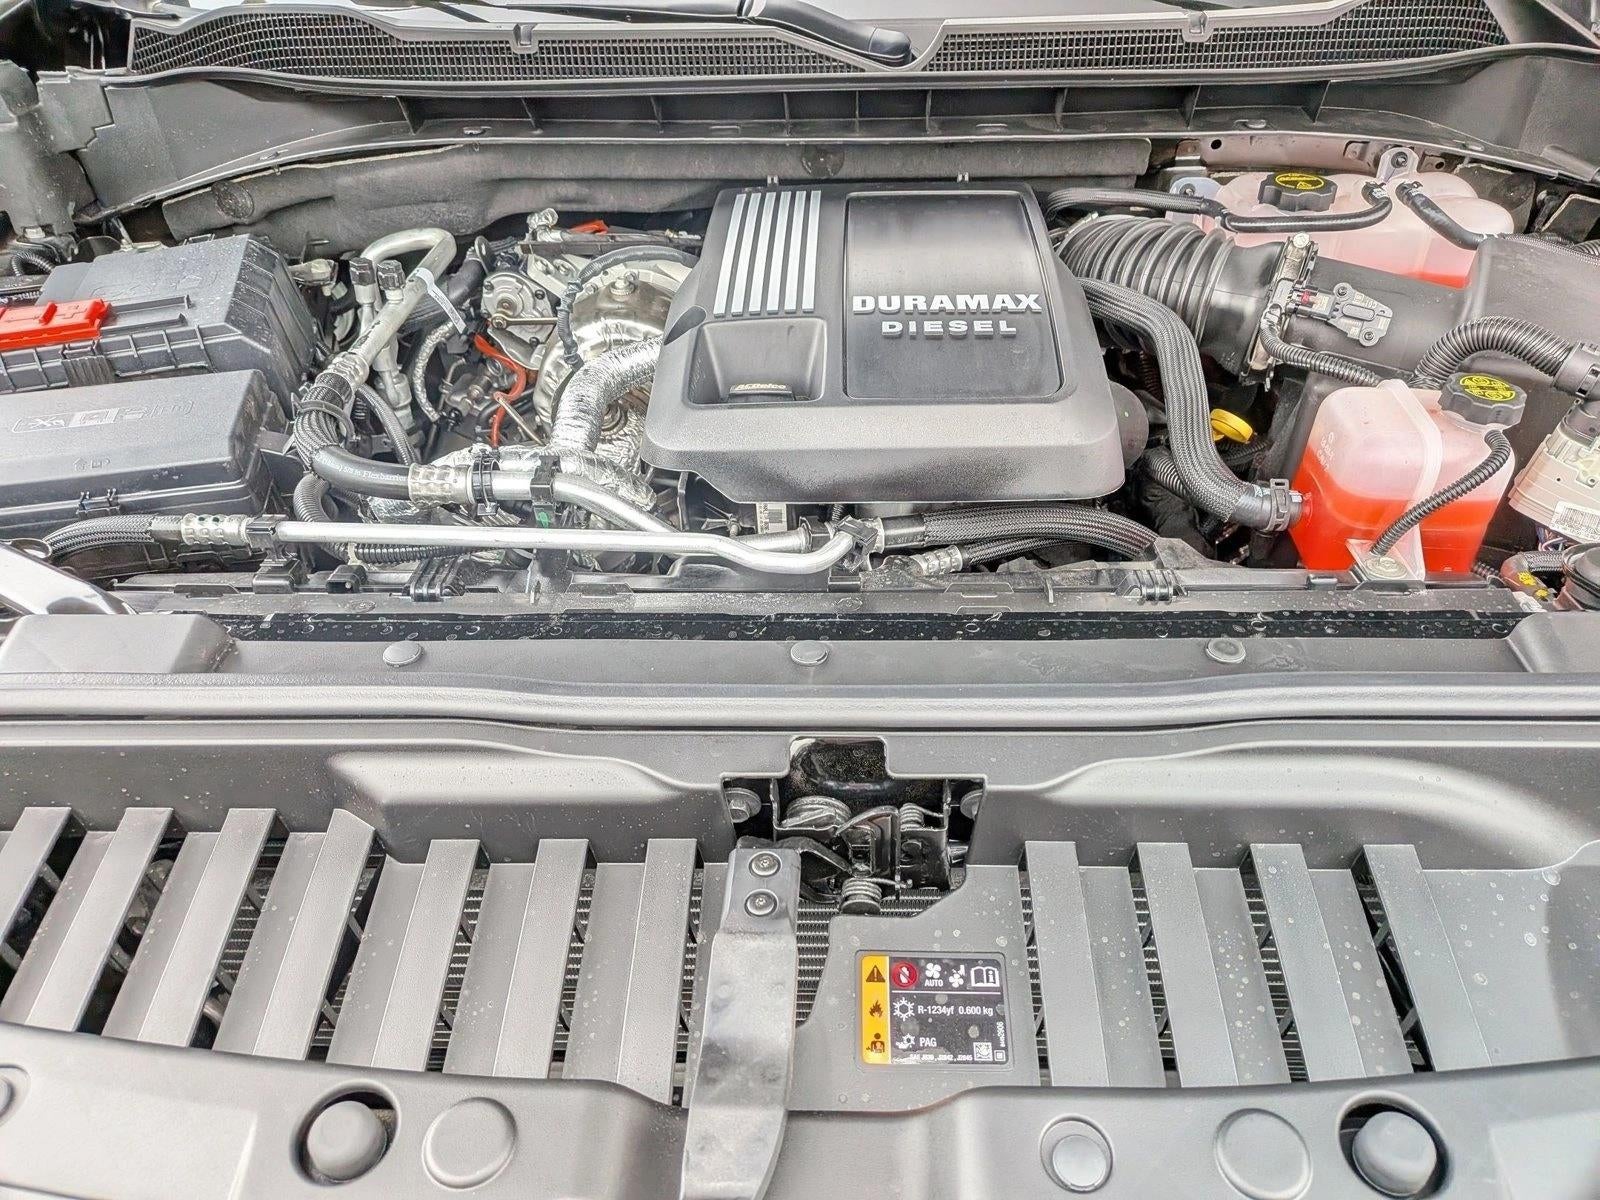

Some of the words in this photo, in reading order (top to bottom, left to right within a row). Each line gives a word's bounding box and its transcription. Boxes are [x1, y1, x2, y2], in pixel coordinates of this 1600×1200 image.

[852, 294, 1042, 314] DURAMAX
[881, 320, 1017, 336] DIESEL
[924, 979, 944, 987] AUTO
[917, 1005, 955, 1015] R-1234yf
[958, 1006, 981, 1015] 0.600
[982, 1006, 994, 1017] kg
[919, 1037, 937, 1047] PAG
